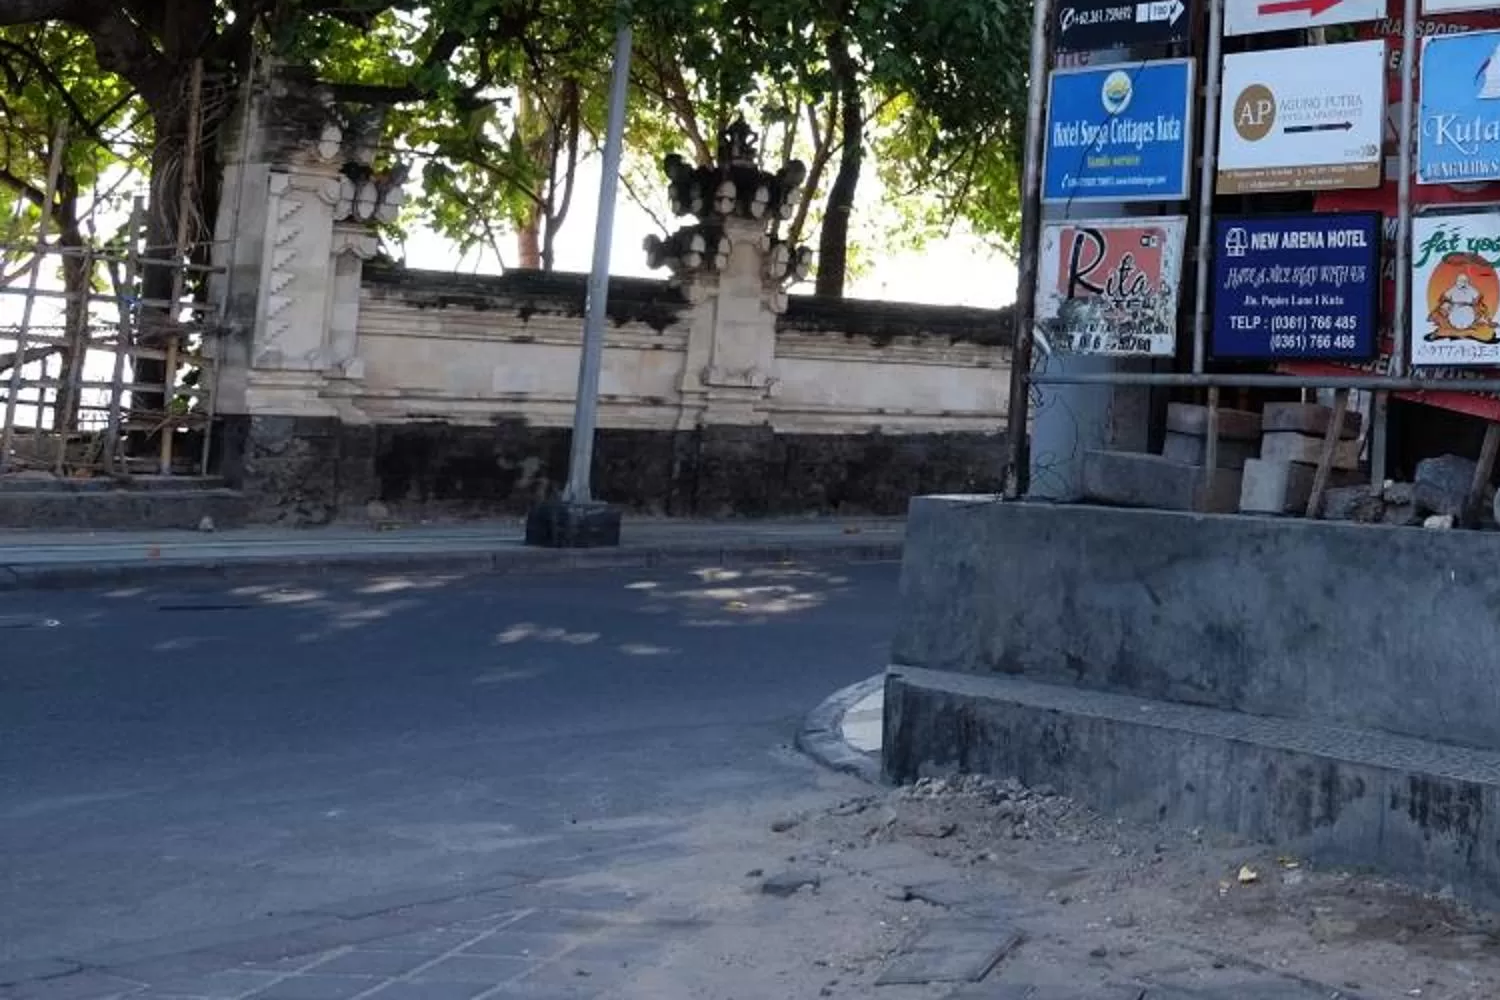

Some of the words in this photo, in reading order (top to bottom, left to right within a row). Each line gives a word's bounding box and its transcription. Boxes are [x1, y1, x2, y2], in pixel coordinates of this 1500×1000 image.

[1238, 100, 1271, 127] AP
[1053, 120, 1079, 148] Hotel
[1112, 118, 1155, 150] Cottages
[1157, 115, 1181, 141] Kuta
[1423, 112, 1500, 156] Kuta
[1252, 231, 1279, 249] NEW
[1282, 231, 1324, 249] ARENA
[1327, 229, 1367, 247] HOTEL
[1068, 227, 1148, 300] Rita
[1321, 295, 1344, 305] Kuta
[1230, 315, 1261, 329] TELP
[1271, 315, 1307, 332] (0361)
[1334, 315, 1357, 329] 485
[1270, 335, 1307, 351] (0361)
